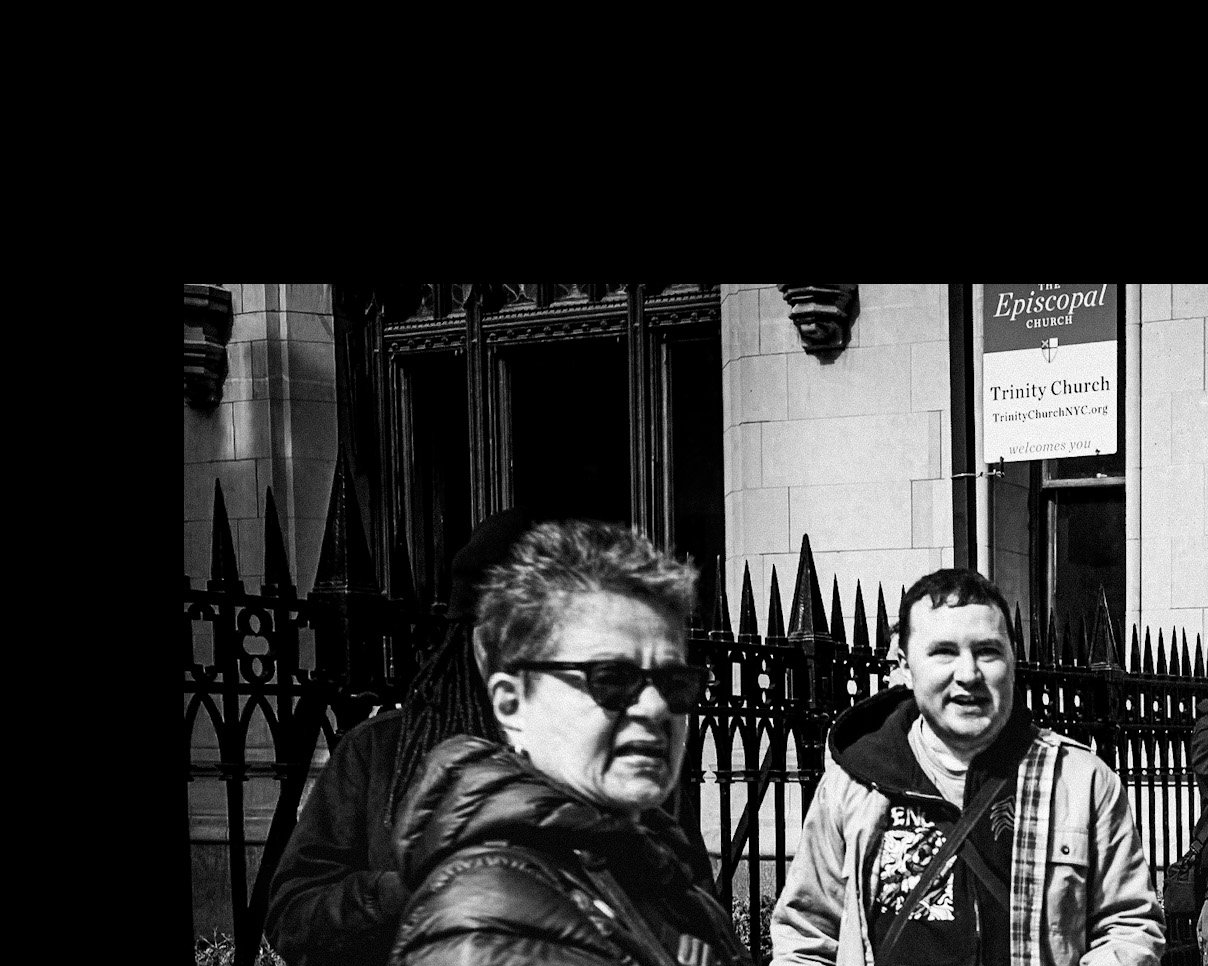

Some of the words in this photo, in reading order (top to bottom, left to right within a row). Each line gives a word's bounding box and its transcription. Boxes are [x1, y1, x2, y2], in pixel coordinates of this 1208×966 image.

[993, 283, 1108, 321] Episcopal
[1025, 315, 1073, 329] CHURCH
[990, 382, 1047, 401] Trinity
[1051, 376, 1111, 396] Church
[992, 405, 1109, 423] TrinityChurchNYC.org
[1009, 441, 1067, 455] welcomes
[1068, 439, 1092, 453] you
